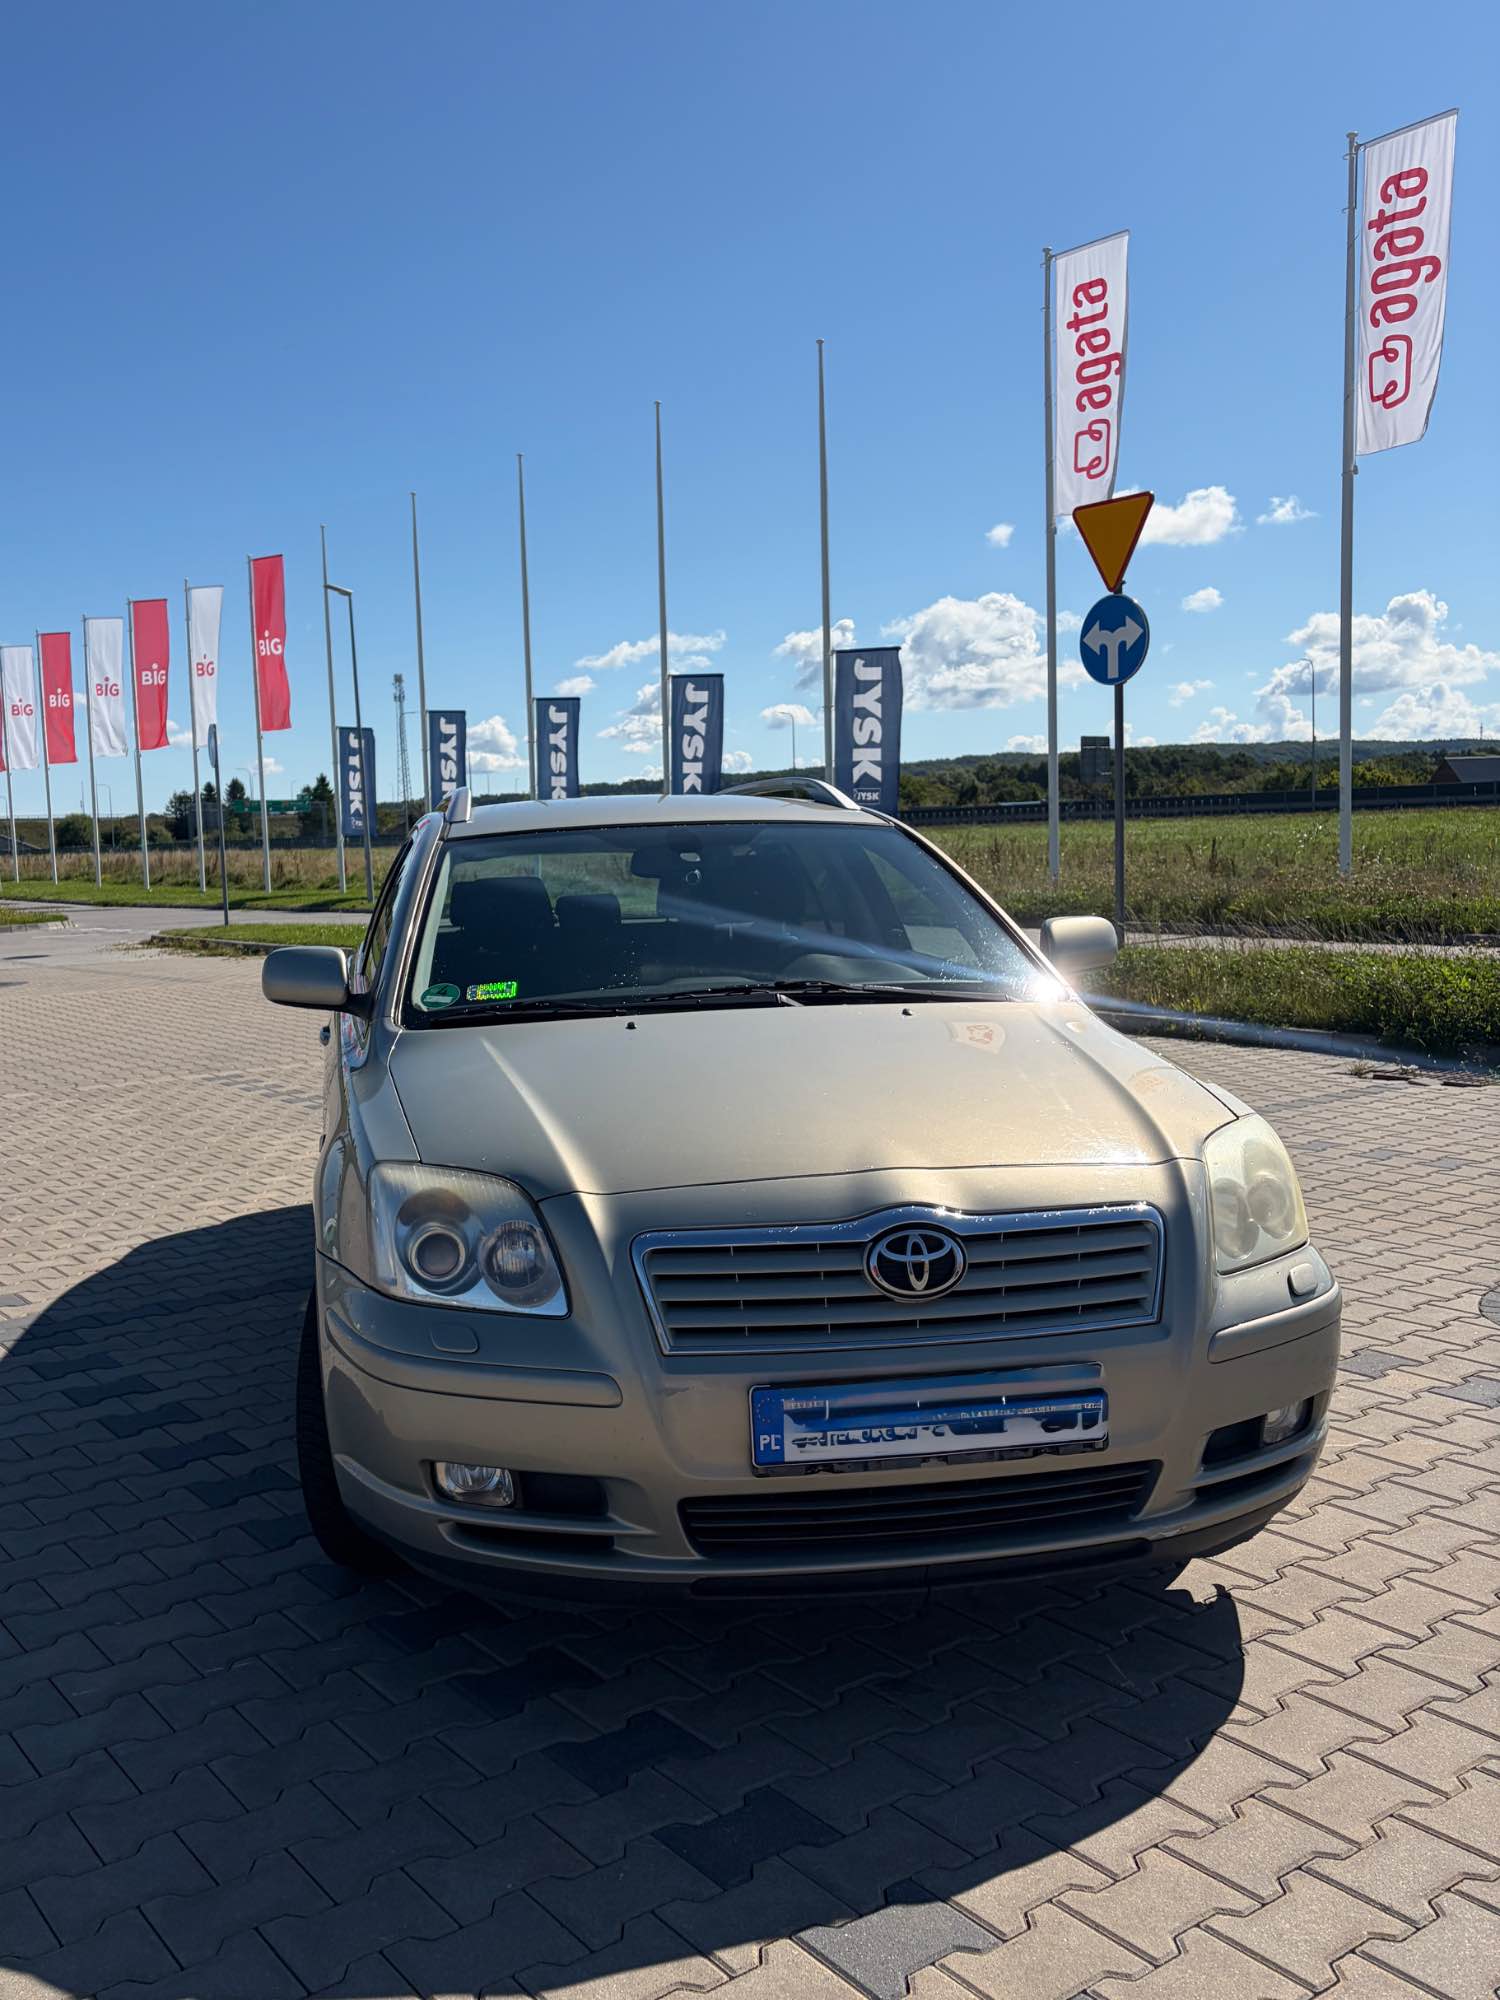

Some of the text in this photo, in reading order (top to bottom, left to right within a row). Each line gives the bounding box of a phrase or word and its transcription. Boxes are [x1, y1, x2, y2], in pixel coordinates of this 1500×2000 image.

[1367, 166, 1441, 328] agata
[1066, 277, 1123, 412] agata
[195, 653, 215, 677] BG
[852, 658, 882, 784] JYSK
[548, 705, 568, 800] JYSK
[682, 682, 709, 793] JYSK
